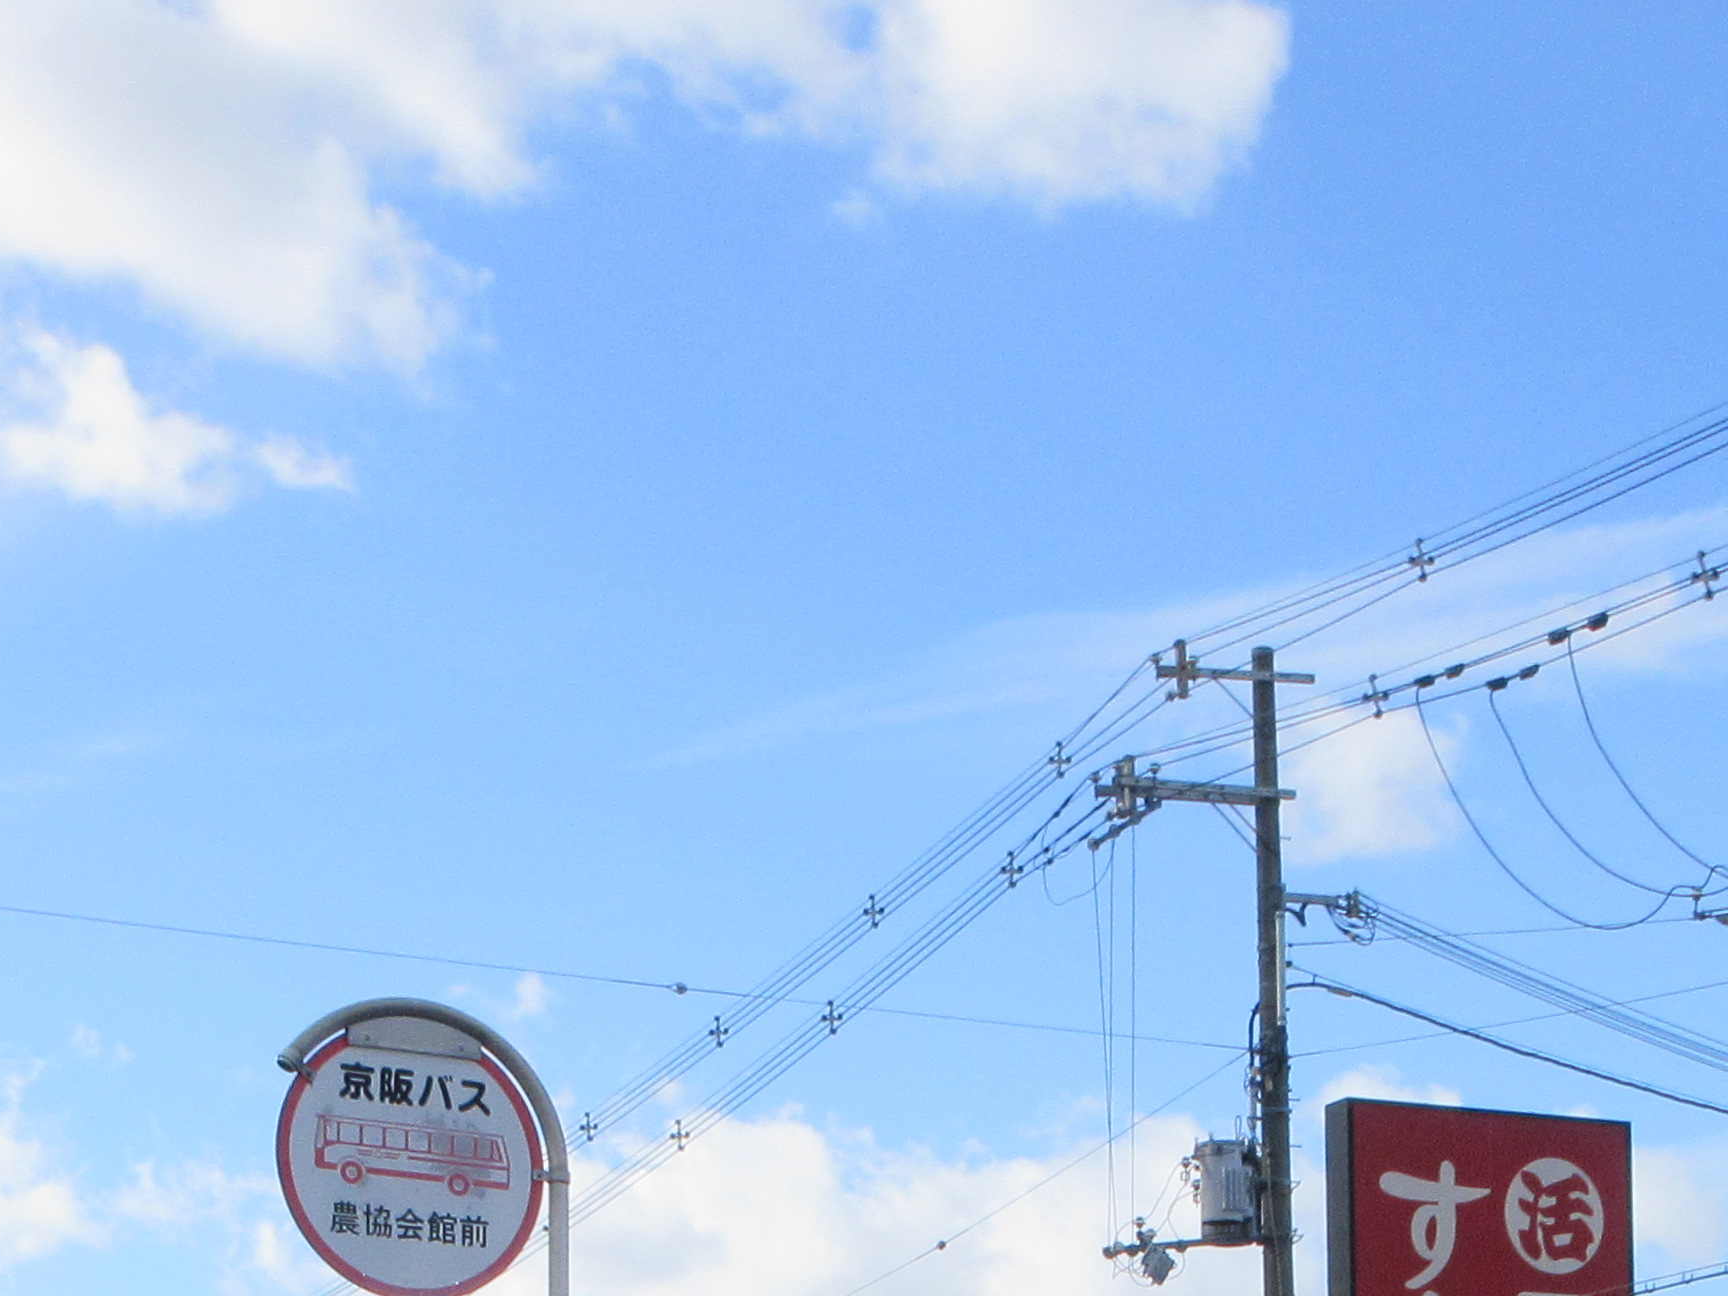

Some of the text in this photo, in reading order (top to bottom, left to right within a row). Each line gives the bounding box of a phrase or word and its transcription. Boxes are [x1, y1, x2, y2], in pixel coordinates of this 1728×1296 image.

[338, 1062, 491, 1116] 京阪バス
[330, 1200, 489, 1248] 農協会館前
[1517, 1168, 1595, 1266] 活
